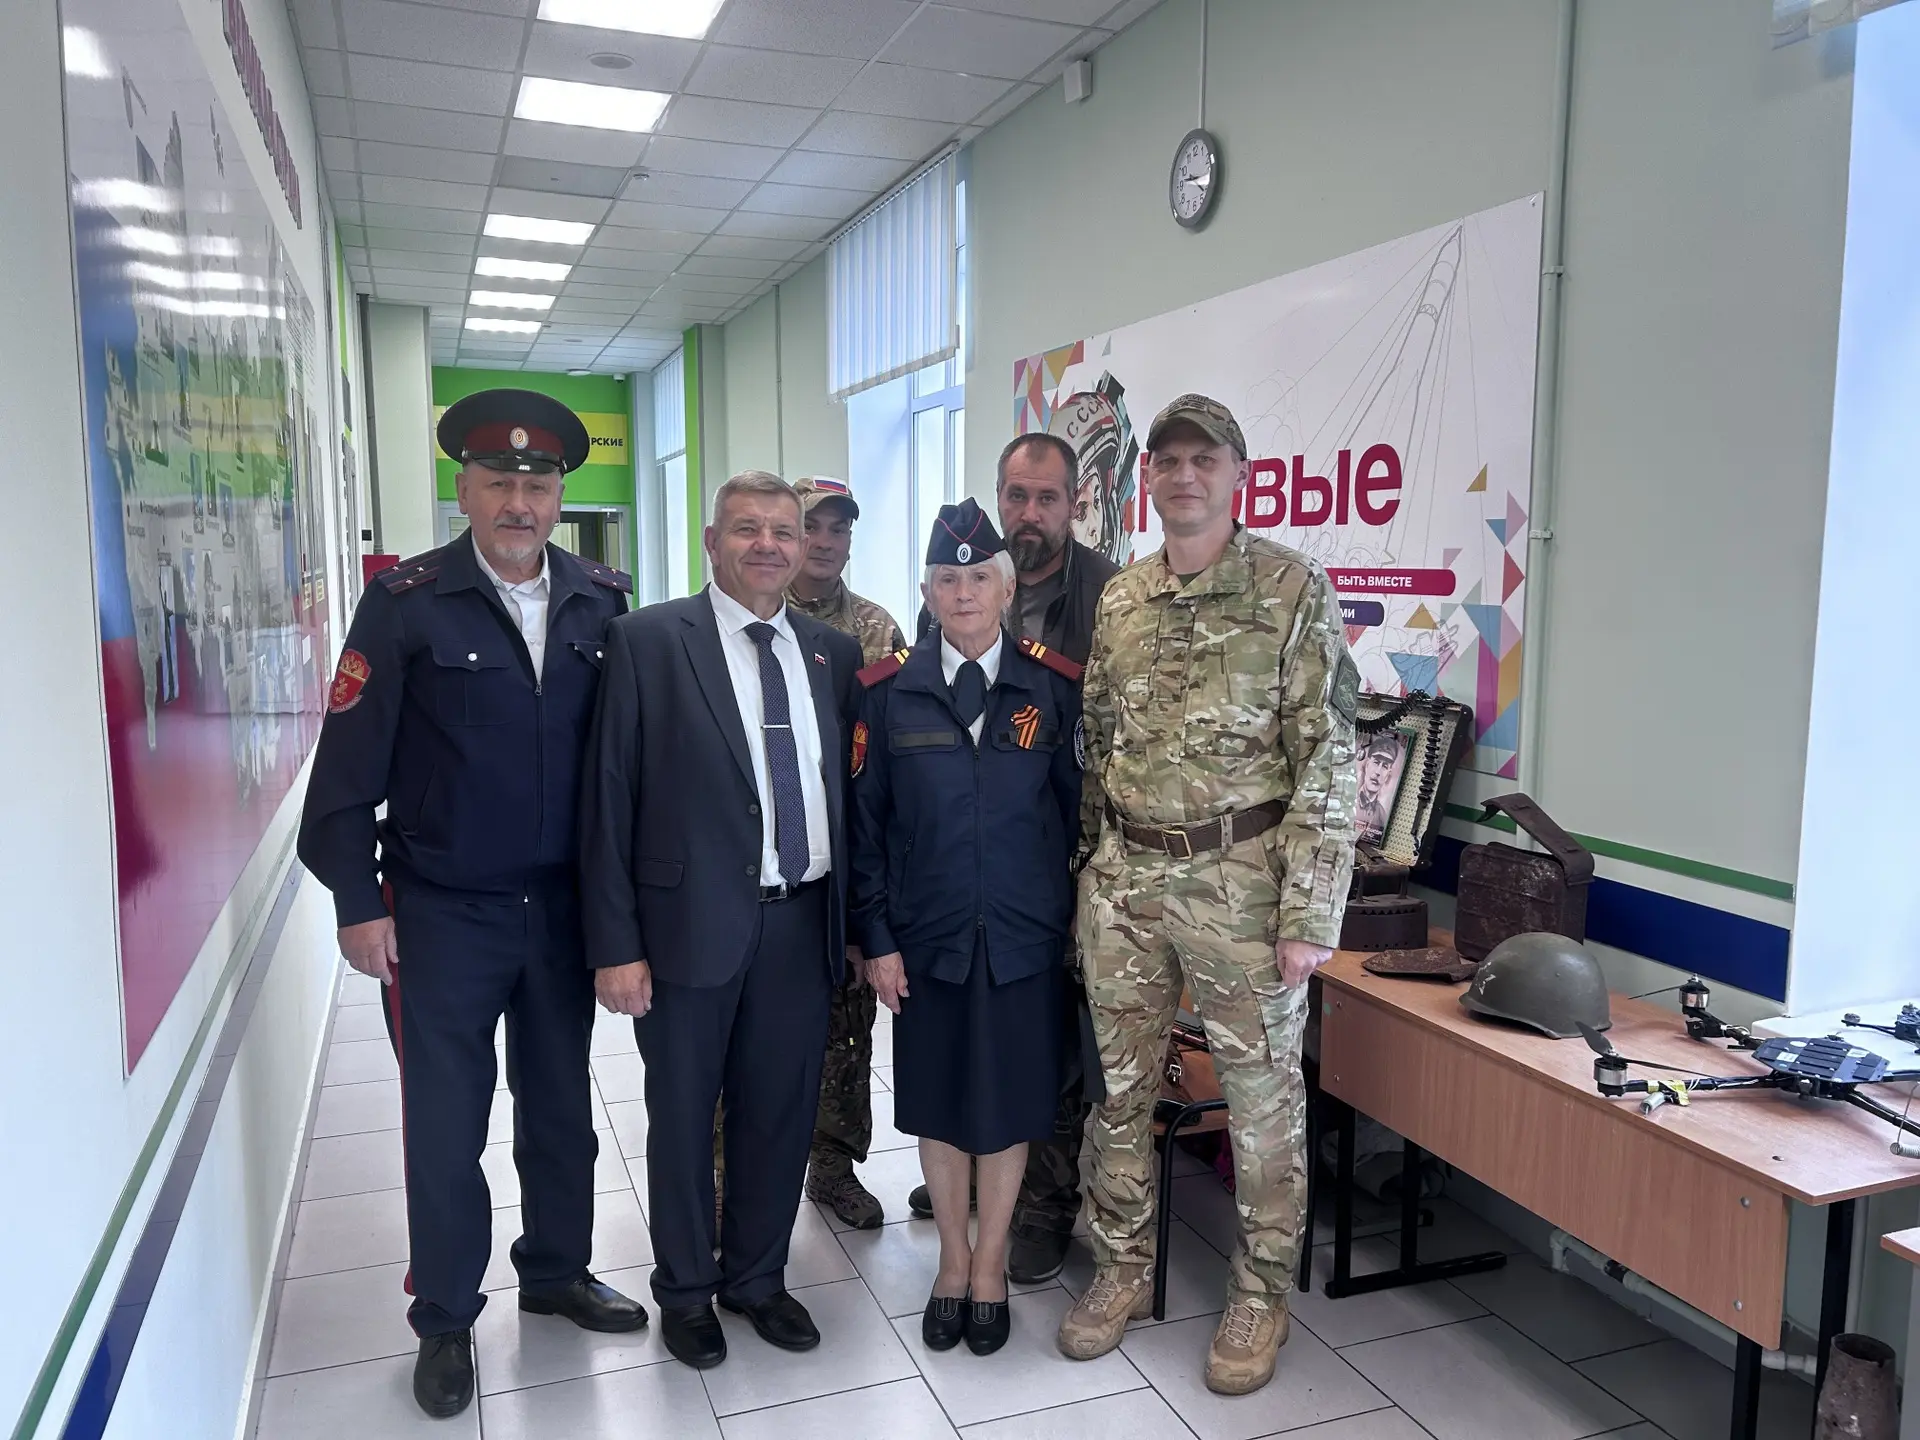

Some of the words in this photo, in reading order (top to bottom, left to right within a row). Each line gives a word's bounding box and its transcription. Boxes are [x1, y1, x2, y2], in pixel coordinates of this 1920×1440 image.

[1180, 165, 1188, 176] 10
[590, 437, 624, 447] РСКИЕ
[1337, 575, 1366, 587] БЫТЬ
[1367, 576, 1413, 588] ВМЕСТЕ
[1339, 607, 1355, 619] МИ
